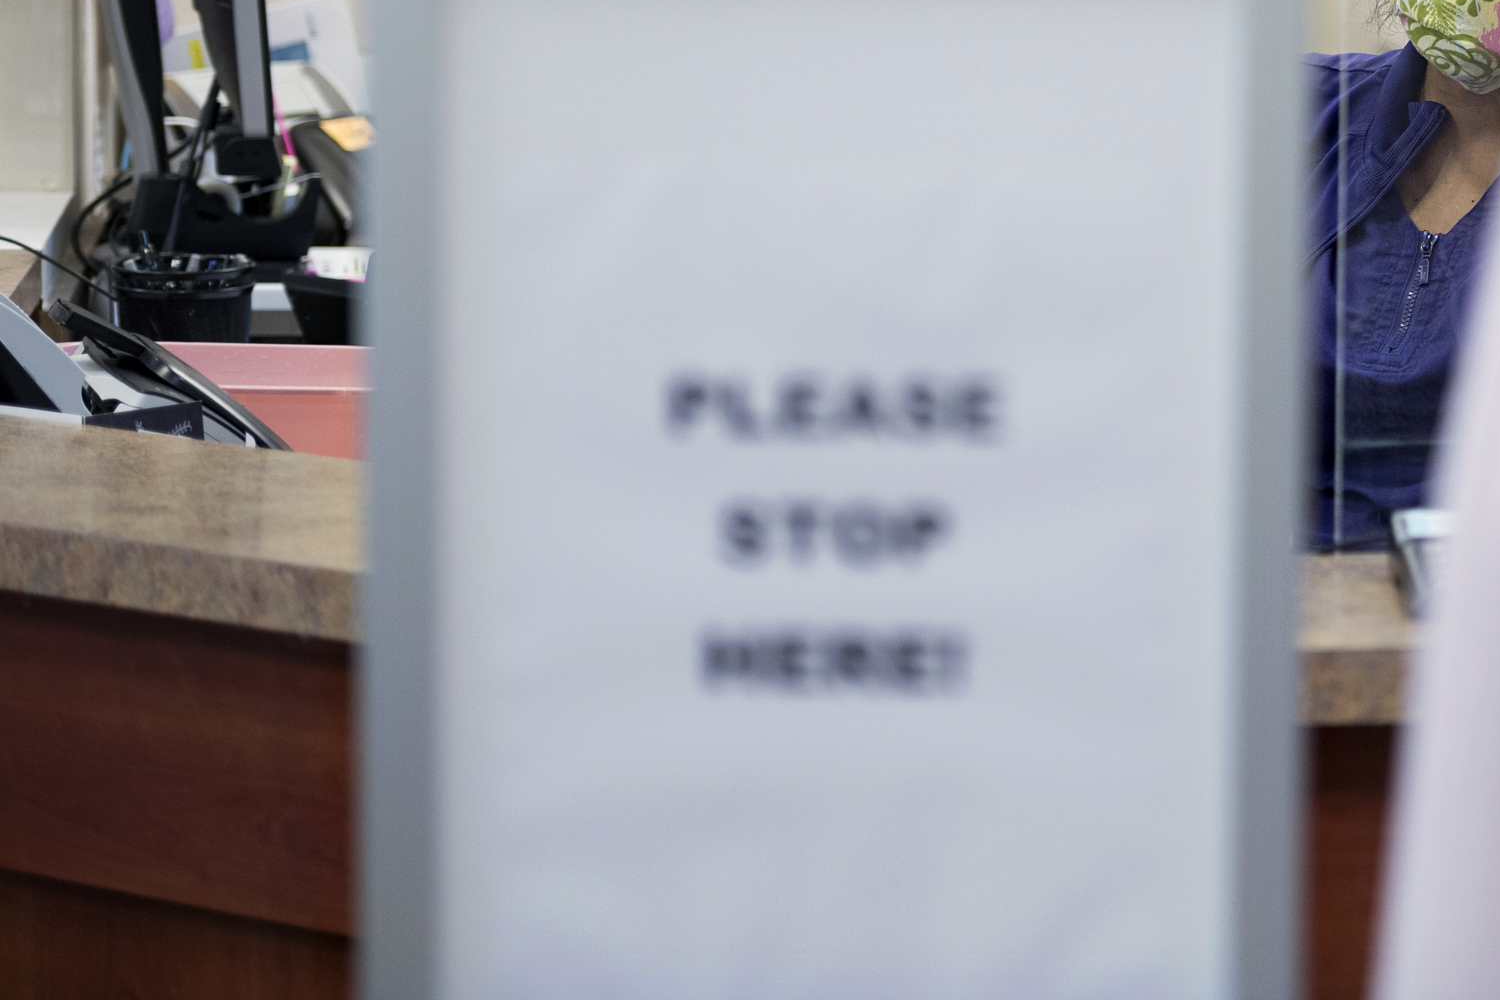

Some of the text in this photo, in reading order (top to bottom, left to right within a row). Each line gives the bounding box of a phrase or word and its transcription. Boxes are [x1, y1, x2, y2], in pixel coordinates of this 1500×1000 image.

[664, 374, 1000, 444] PLEASE
[719, 499, 952, 567] STOP
[697, 625, 969, 695] HERE!
